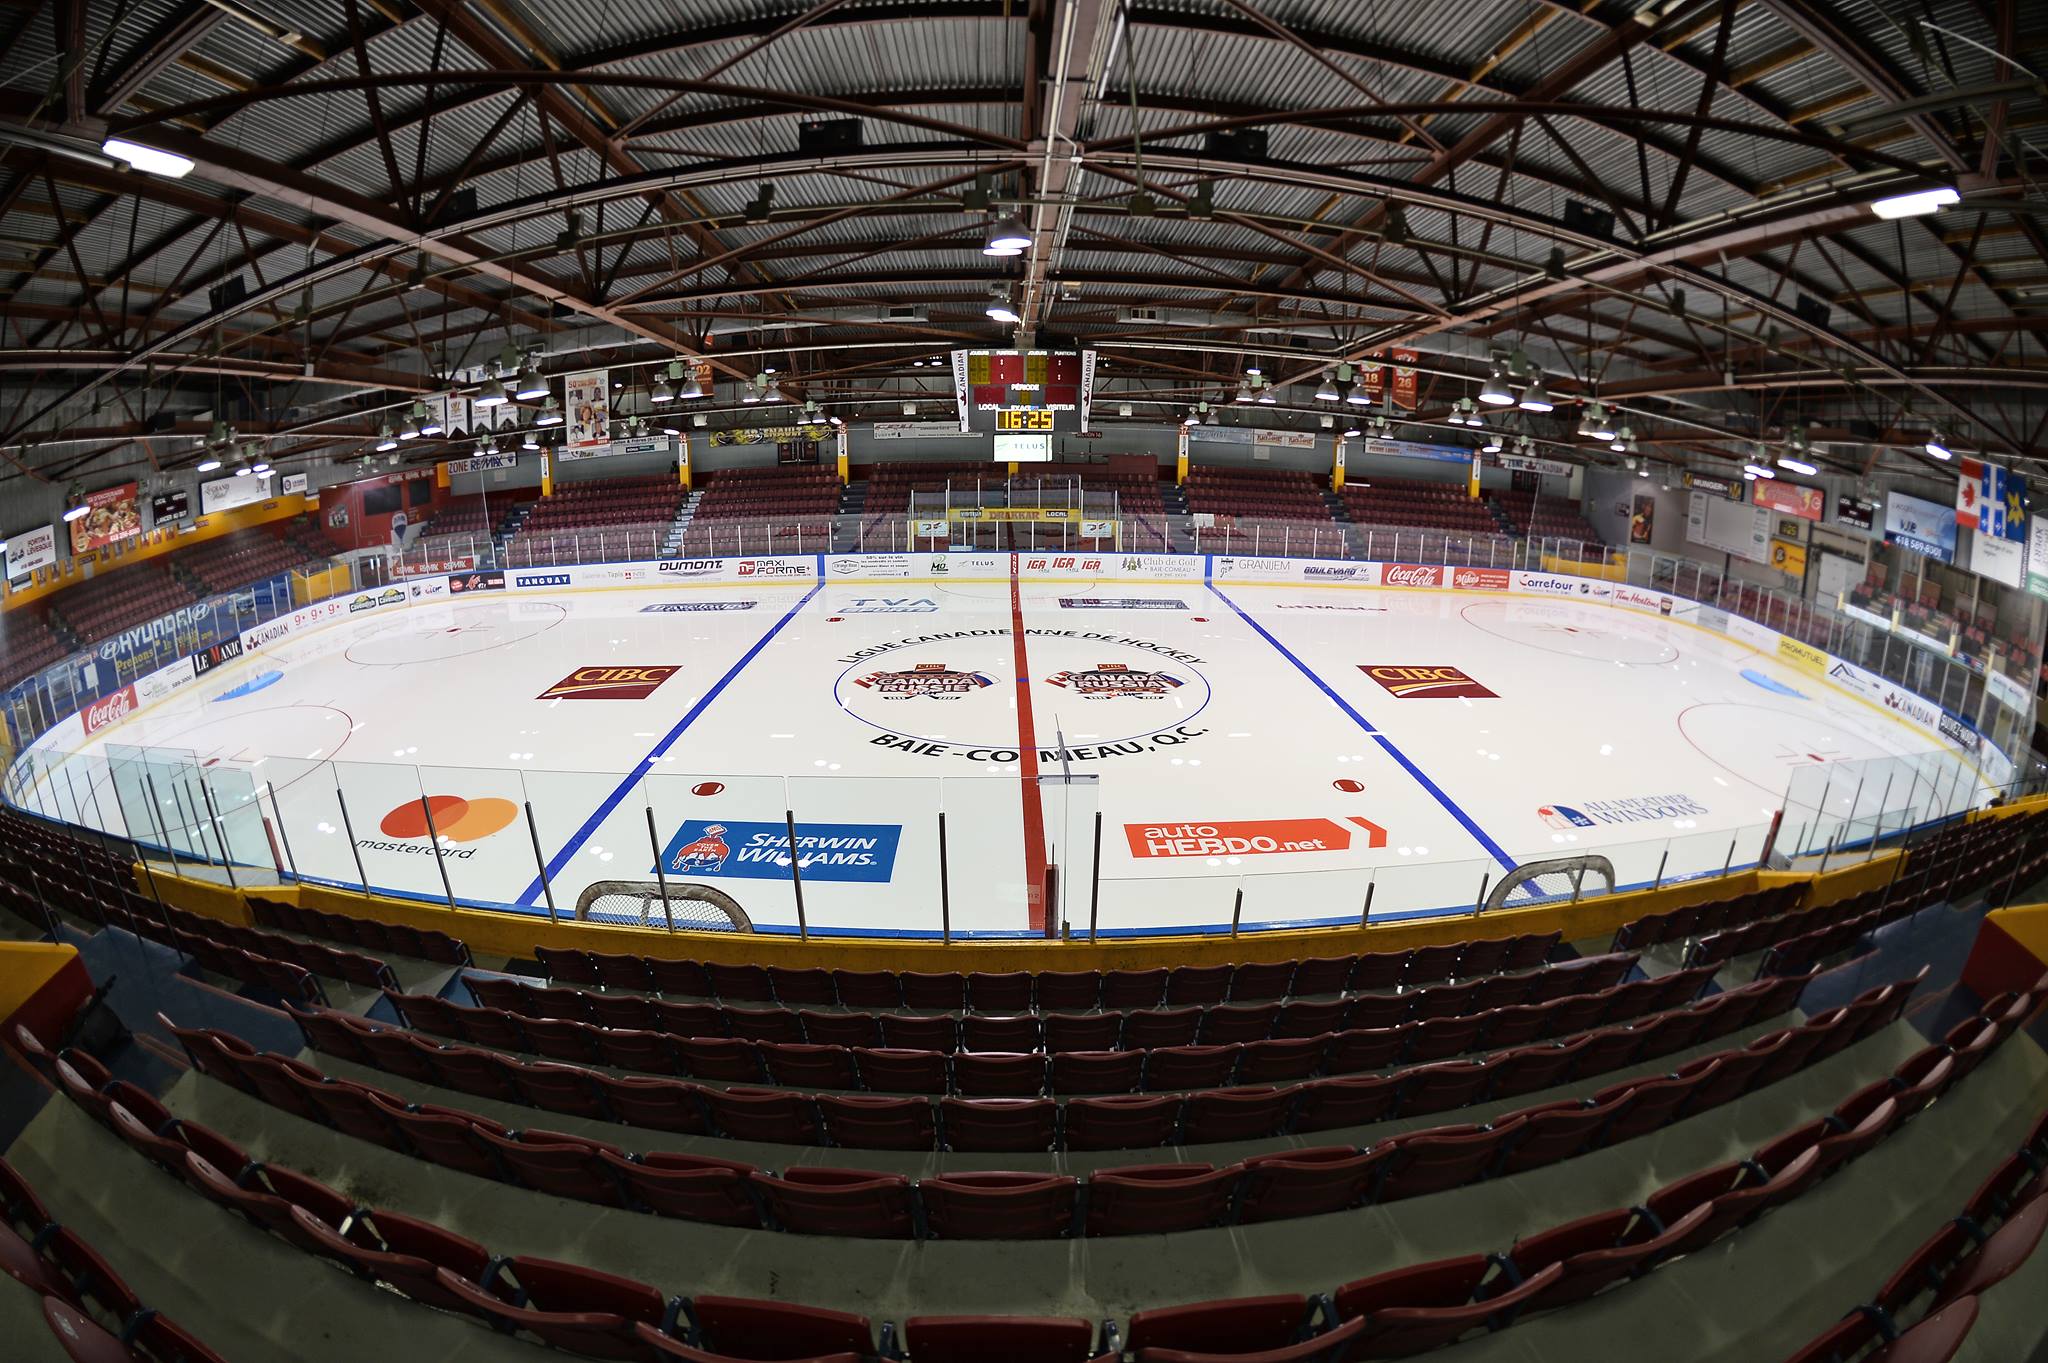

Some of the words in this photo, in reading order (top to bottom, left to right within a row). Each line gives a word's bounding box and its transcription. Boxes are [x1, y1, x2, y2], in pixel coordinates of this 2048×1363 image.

[958, 353, 966, 391] CANADIAN
[1084, 353, 1092, 392] CANADIAN
[1364, 373, 1379, 383] 18
[1398, 377, 1412, 388] 26
[1005, 411, 1052, 429] 16:25
[448, 461, 469, 474] ZONE
[989, 511, 1040, 520] DRAKKAR
[659, 560, 723, 571] DUMONT
[1026, 560, 1047, 570] IGA
[1052, 557, 1076, 568] IGA
[1081, 560, 1101, 570] IGA
[1143, 557, 1164, 566] Club
[1165, 557, 1176, 566] de
[1178, 557, 1198, 566] Golf
[1304, 566, 1356, 576] BOULEVARD
[1387, 566, 1439, 586] Coca-Cola
[518, 576, 568, 586] TANGUAY
[1519, 574, 1574, 591] Carrefour
[1616, 589, 1630, 601] Tim
[1631, 593, 1660, 609] Hortons
[118, 607, 193, 654] HYUNDAI
[256, 623, 289, 647] CANADIAN
[194, 652, 209, 673] LE
[211, 638, 241, 665] MANIC
[837, 642, 903, 664] LIGUE
[901, 629, 1077, 645] CANADIENNE
[1082, 632, 1117, 641] DE
[1118, 637, 1208, 665] HOCKEY
[1781, 640, 1825, 666] PROMUTUEL
[573, 667, 676, 682] CIBC
[878, 678, 975, 686] CANADA
[1371, 667, 1466, 681] CIBC
[1077, 680, 1163, 688] RUSSIA
[1897, 697, 1936, 728] CANADIAN
[1611, 793, 1690, 810] WEATHER
[1592, 802, 1709, 825] WINDOWS
[1144, 825, 1219, 839] auto
[355, 838, 478, 860] mastercard
[745, 833, 878, 850] SHERWIN
[1146, 836, 1327, 856] HEBDO.net
